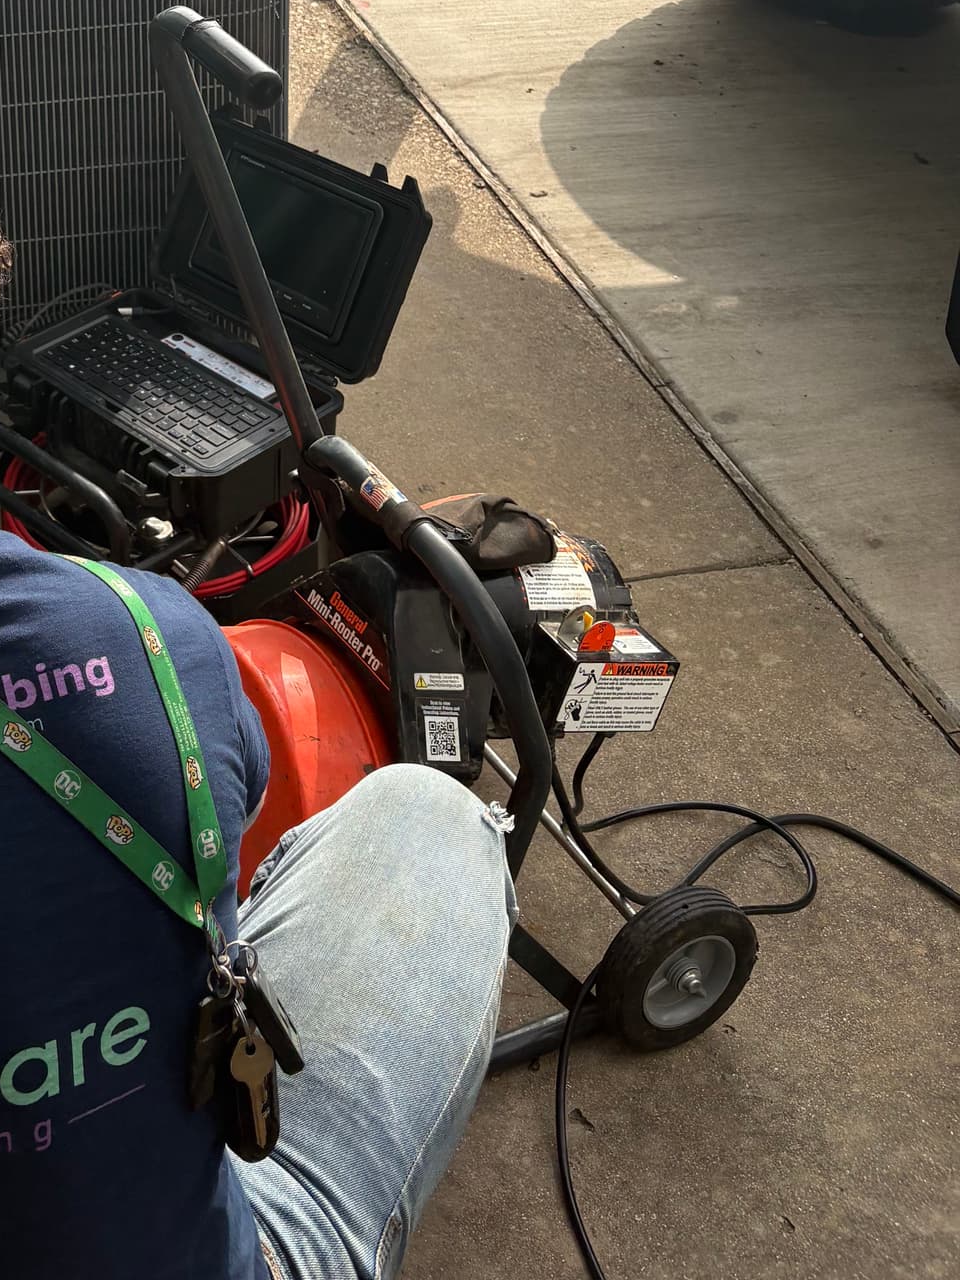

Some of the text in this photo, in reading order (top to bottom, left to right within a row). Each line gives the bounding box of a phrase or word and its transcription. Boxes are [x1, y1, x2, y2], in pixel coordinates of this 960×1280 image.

[329, 591, 369, 635] General
[307, 589, 381, 672] Mini-Rooter Pro
[616, 664, 665, 676] WARNING
[5, 721, 32, 750] POP!
[55, 771, 81, 800] DC
[107, 815, 135, 843] POP!
[152, 862, 174, 890] DC
